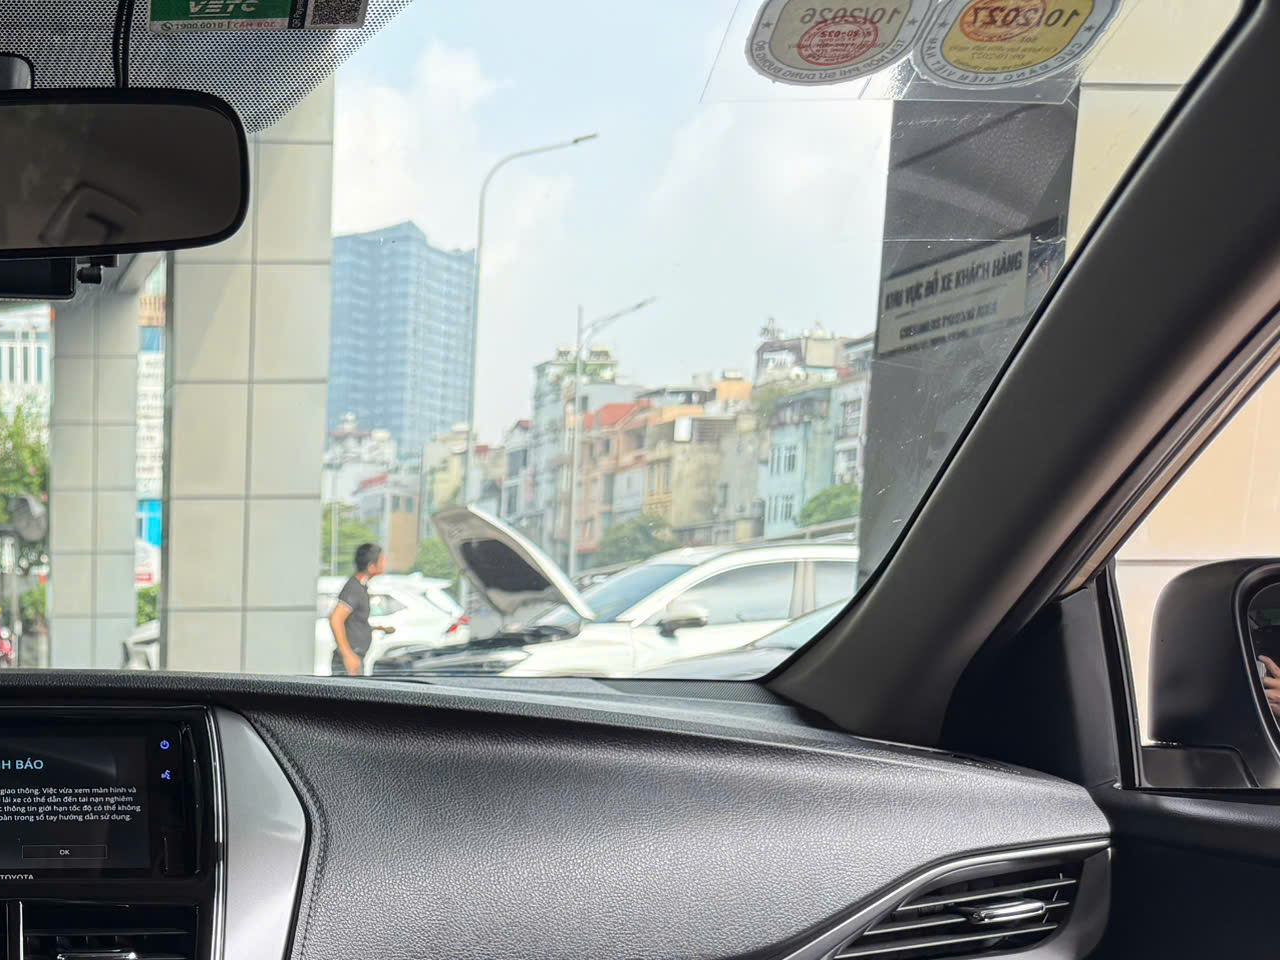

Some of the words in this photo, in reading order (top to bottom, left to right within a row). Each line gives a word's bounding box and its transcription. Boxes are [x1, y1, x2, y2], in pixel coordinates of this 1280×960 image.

[189, 0, 258, 13] VETC
[940, 275, 954, 292] XE
[15, 757, 44, 770] BÁO
[0, 787, 16, 796] giao
[16, 787, 41, 796] thông.
[41, 787, 58, 796] Việc
[33, 795, 46, 803] thể
[46, 795, 62, 803] dẫn
[62, 795, 77, 803] đến
[105, 795, 133, 804] nghiêm
[3, 804, 26, 814] thông
[38, 804, 52, 813] giới
[53, 804, 68, 813] hạn
[68, 803, 81, 811] tốc
[82, 804, 93, 813] độ
[103, 803, 117, 811] thể
[117, 804, 141, 813] không
[14, 813, 35, 822] trong
[35, 812, 45, 820] sổ
[45, 813, 58, 822] tay
[58, 813, 84, 822] hướng
[84, 812, 99, 820] dẫn
[110, 812, 132, 822] dụng.
